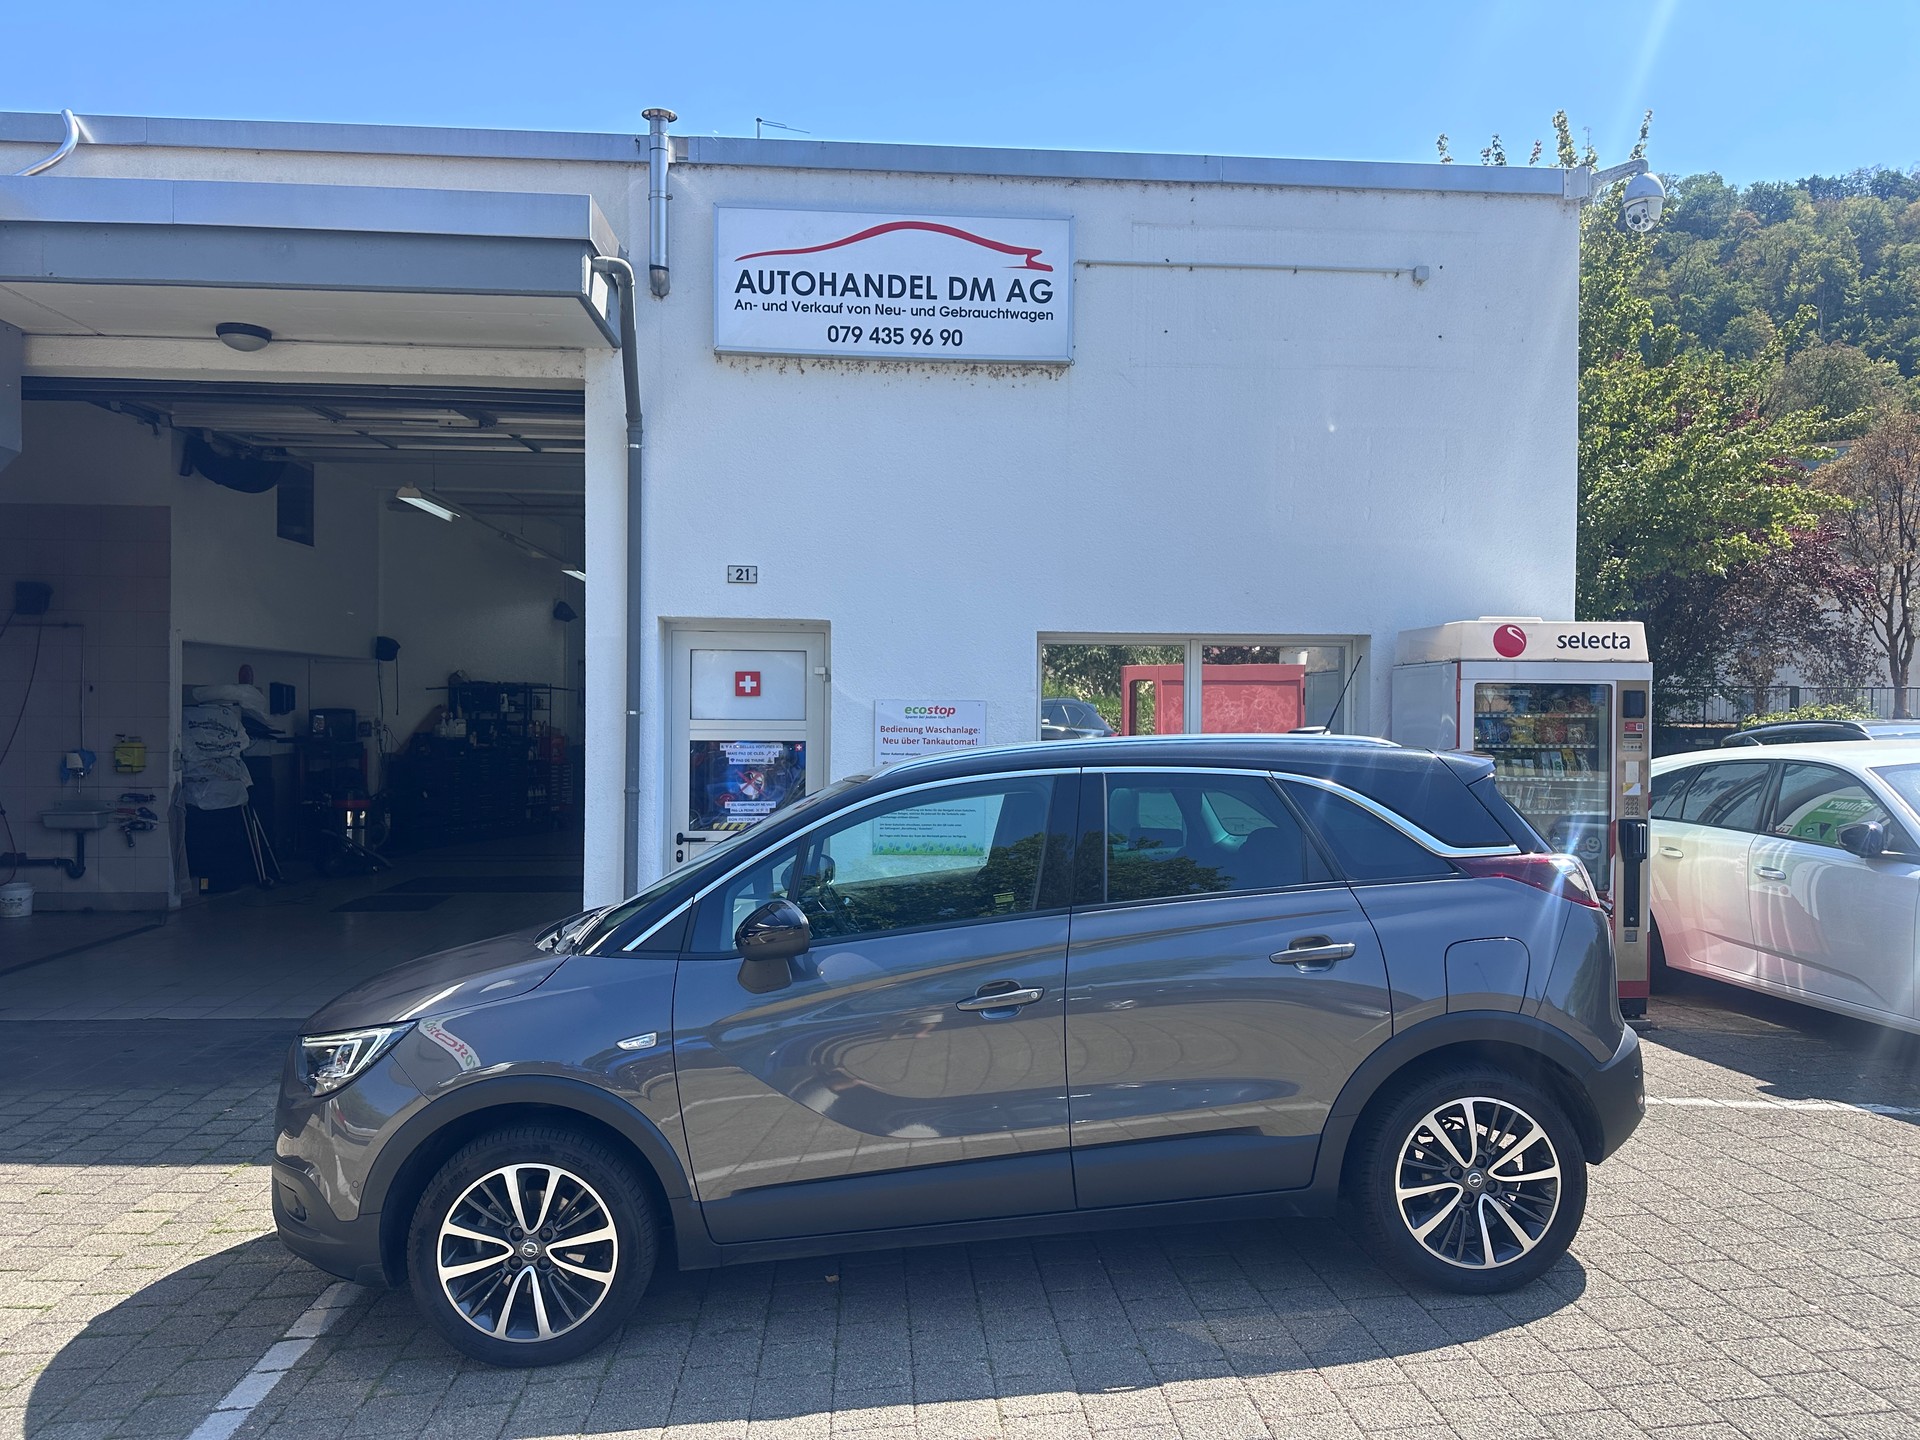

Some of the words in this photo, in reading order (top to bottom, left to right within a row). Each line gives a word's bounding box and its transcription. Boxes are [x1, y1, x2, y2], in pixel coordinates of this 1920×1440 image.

[734, 269, 938, 301] AUTOHANDEL
[948, 276, 996, 303] DM
[1005, 278, 1054, 304] AG
[734, 299, 758, 312] An-
[762, 300, 788, 312] und
[791, 301, 843, 315] Verkauf
[847, 304, 871, 316] von
[875, 304, 907, 317] Neu-
[911, 305, 936, 318] und
[939, 306, 1054, 323] Gebrauchtwagen
[827, 325, 863, 344] 079
[869, 327, 905, 345] 435
[910, 328, 935, 346] 96
[939, 329, 963, 347] 90
[735, 568, 750, 581] 21
[1556, 631, 1631, 649] selecta
[904, 705, 956, 717] ecostop
[880, 725, 924, 735] Bedienung
[925, 726, 981, 736] Waschanlage:
[882, 737, 899, 745] Neu
[901, 737, 920, 745] über
[922, 737, 978, 746] Tankautomat!
